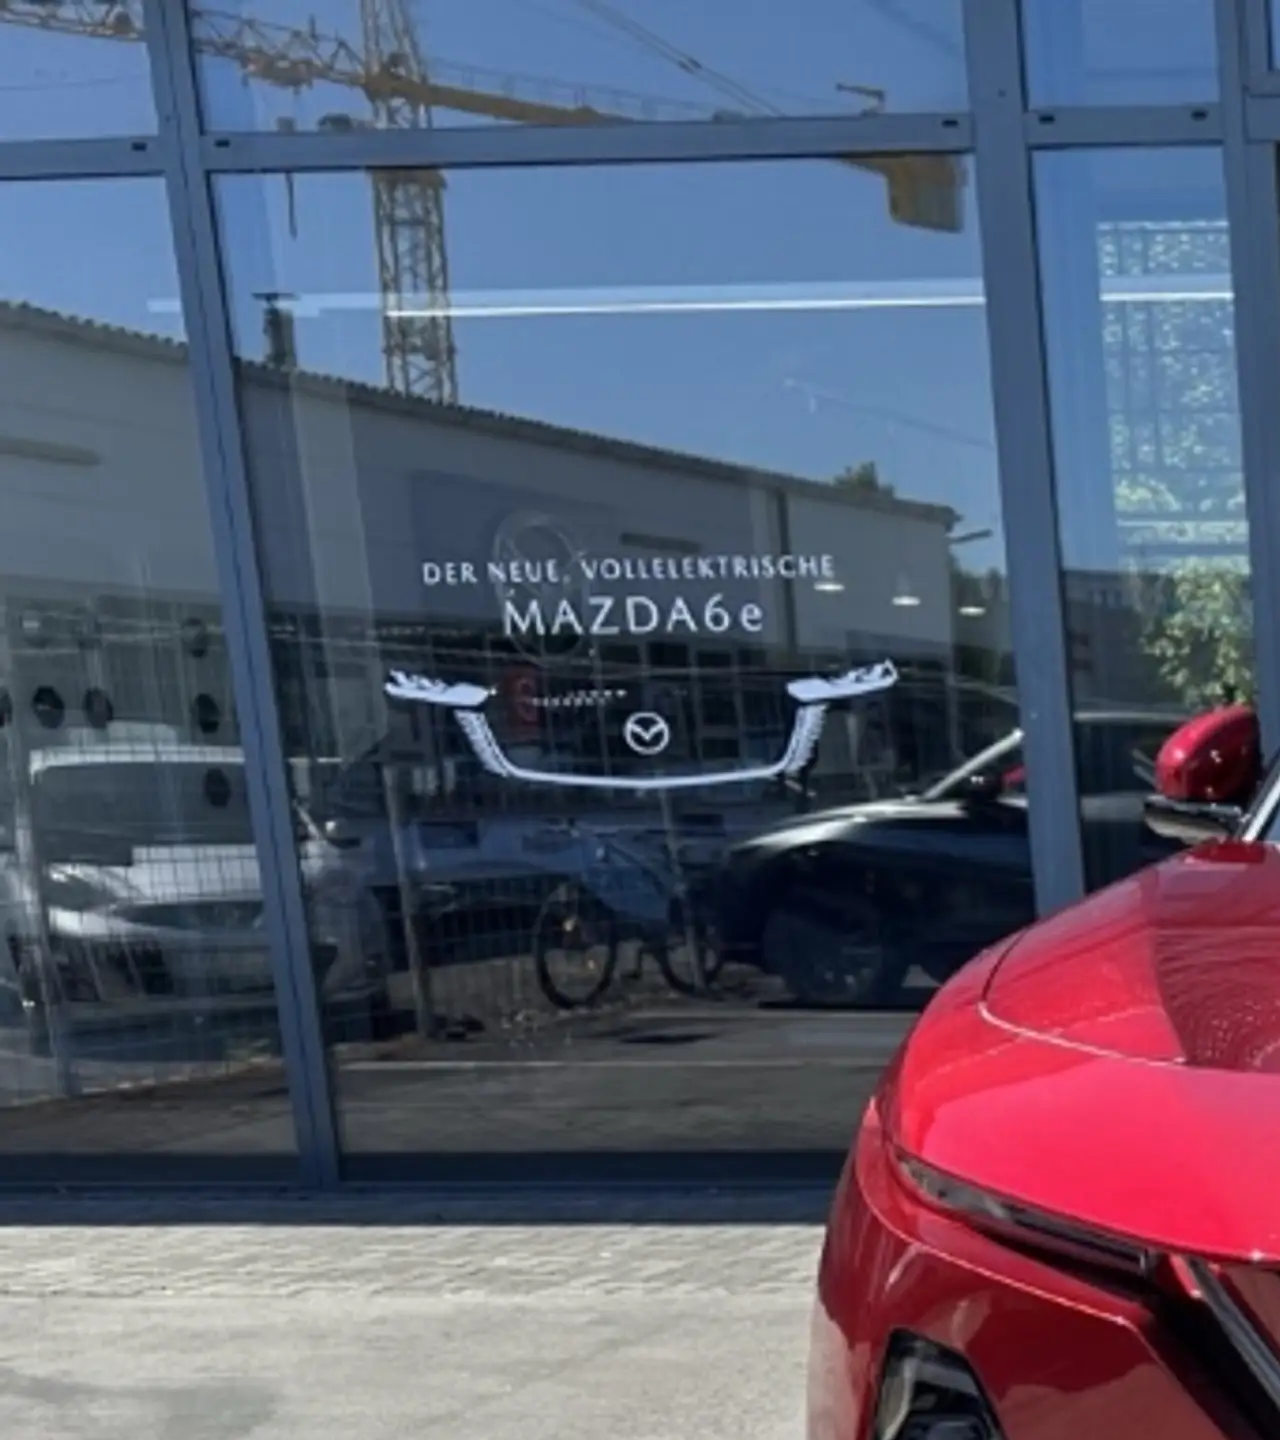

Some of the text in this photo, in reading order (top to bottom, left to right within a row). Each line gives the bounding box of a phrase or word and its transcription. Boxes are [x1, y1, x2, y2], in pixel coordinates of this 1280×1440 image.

[423, 562, 478, 585] DER
[579, 554, 835, 580] VOLLELEKTRISCHE
[504, 593, 763, 636] MAZDA6e
